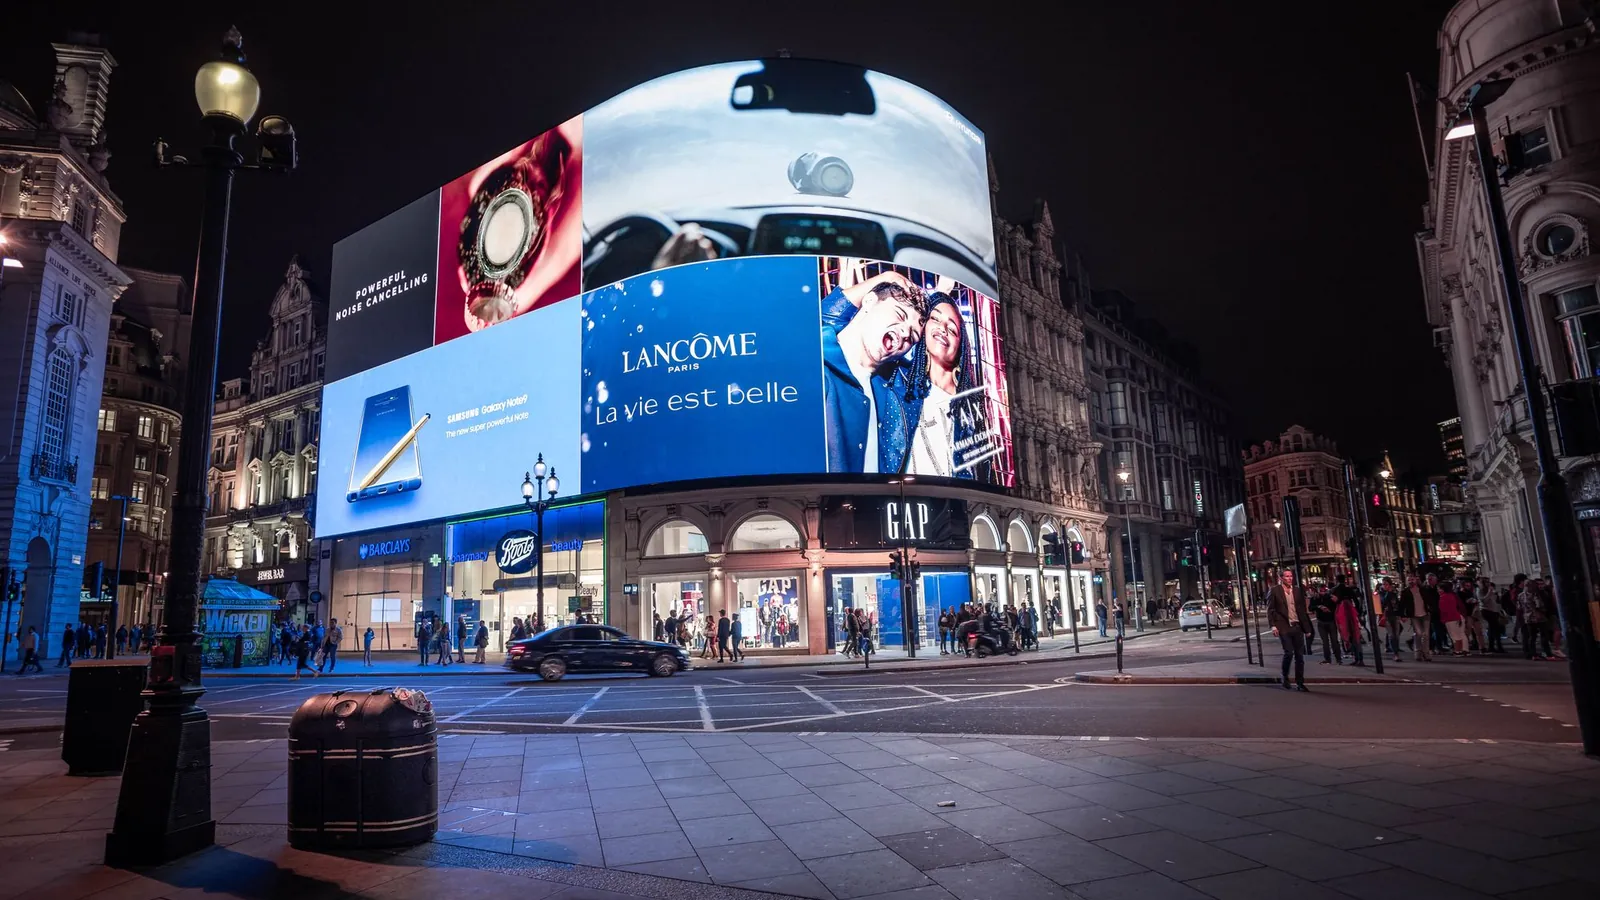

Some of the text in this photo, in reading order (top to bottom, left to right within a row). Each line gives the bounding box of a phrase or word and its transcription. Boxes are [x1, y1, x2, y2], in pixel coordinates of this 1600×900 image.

[49, 256, 96, 297] ALLIANCE LIFE OFFICE
[355, 269, 406, 300] POWERFUL
[335, 273, 428, 321] NOISE CANCELLING
[622, 332, 757, 374] LANCÔME
[667, 362, 700, 374] PARIS
[447, 394, 528, 424] SAMSUNG Galaxy Note9
[596, 381, 798, 426] La vie est belle
[445, 411, 529, 439] The new super powerful Note
[952, 436, 974, 452] ARMANI
[886, 502, 928, 540] GAP
[368, 538, 411, 557] BARCLAYS
[450, 551, 489, 566] pharmacy
[499, 535, 535, 568] Boots
[551, 539, 584, 553] beauty
[579, 585, 598, 597] beauty
[758, 578, 792, 597] GAP
[205, 609, 268, 633] WICKED
